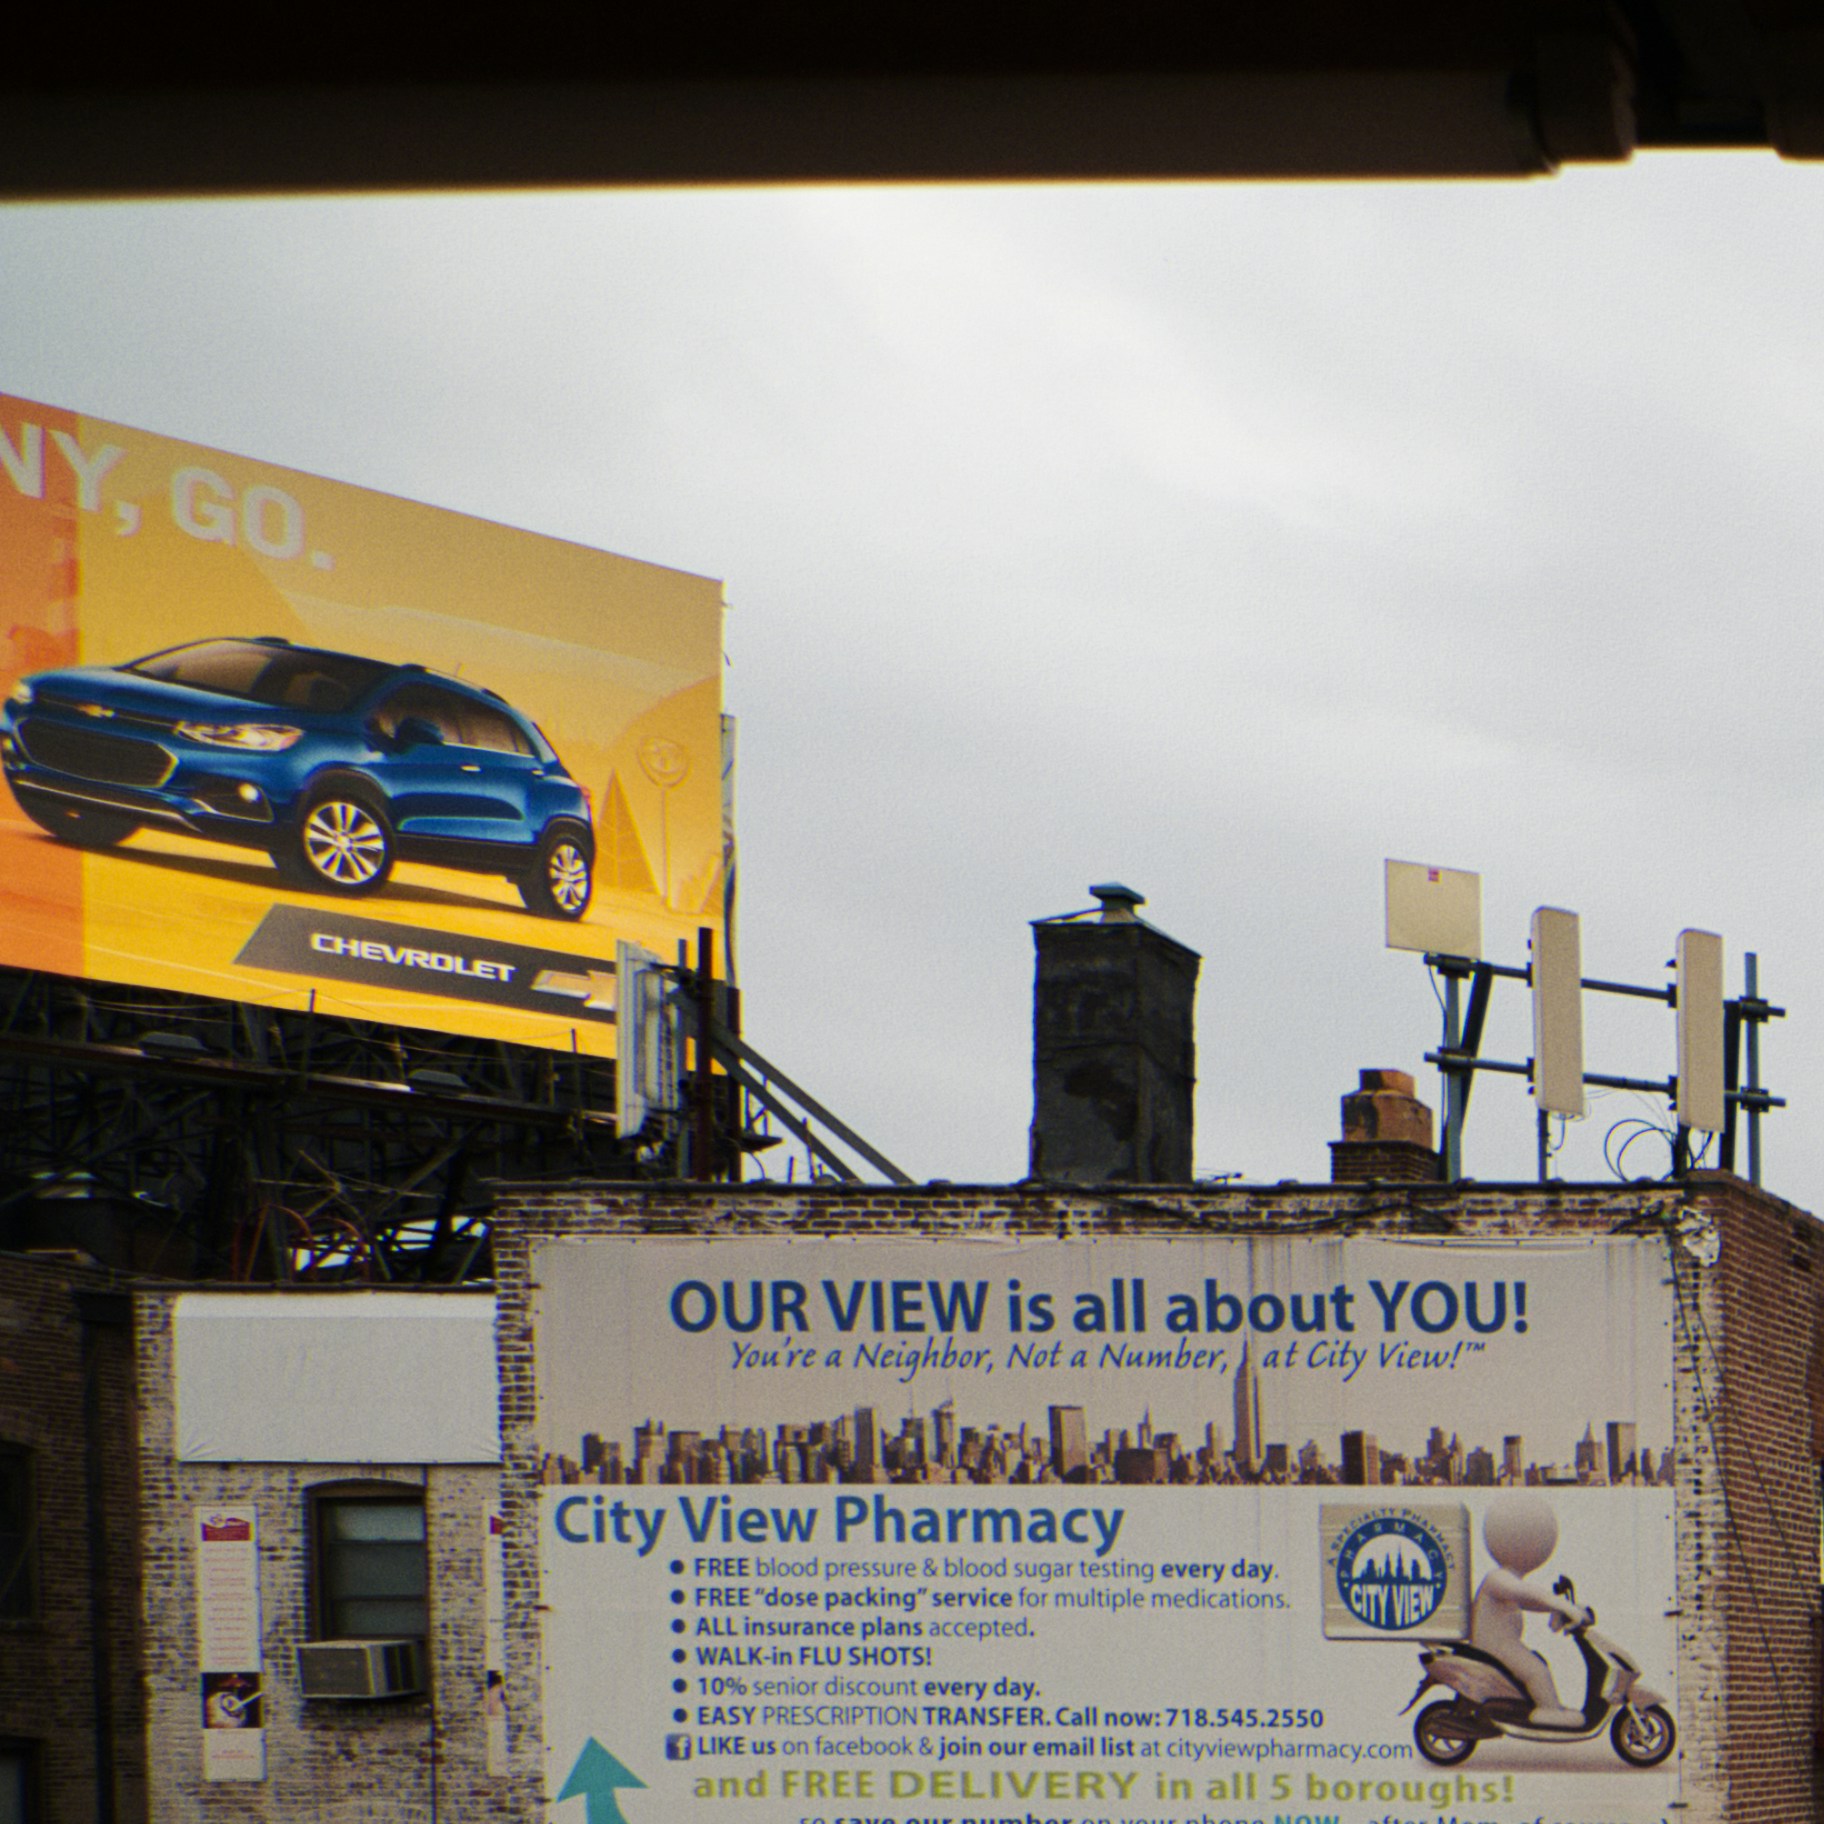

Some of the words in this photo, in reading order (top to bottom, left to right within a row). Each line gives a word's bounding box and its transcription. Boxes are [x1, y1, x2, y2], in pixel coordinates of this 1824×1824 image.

[171, 466, 336, 571] GO.
[311, 933, 516, 983] CHEVROLET
[669, 1279, 810, 1334] OUR
[821, 1279, 990, 1333] VIEW
[1007, 1278, 1056, 1334] is
[1072, 1277, 1147, 1333] all
[1165, 1277, 1356, 1334] about
[1368, 1279, 1529, 1334] YOU!
[823, 1349, 842, 1369] a
[853, 1336, 996, 1384] Neighbor,
[1006, 1341, 1063, 1369] Not
[1069, 1349, 1088, 1369] a
[1098, 1336, 1229, 1373] Number,
[1262, 1343, 1299, 1369] at
[1306, 1340, 1368, 1383] City
[554, 1494, 667, 1558] City
[678, 1494, 819, 1543] View
[834, 1493, 1126, 1558] Pharmacy
[1339, 1521, 1444, 1579] PHARMACY
[693, 1557, 750, 1577] FREE
[755, 1557, 819, 1578] blood
[824, 1562, 918, 1581] pressure
[922, 1559, 938, 1577] &
[944, 1557, 1008, 1578] blood
[1013, 1563, 1074, 1582] sugar
[1079, 1559, 1155, 1583] testing
[1160, 1563, 1226, 1582] every
[1231, 1558, 1279, 1582] day.
[694, 1588, 751, 1607] FREE
[932, 1587, 1013, 1608] service
[1019, 1586, 1050, 1608] for
[1055, 1587, 1146, 1612] multiple
[1151, 1588, 1292, 1609] medications.
[1351, 1583, 1389, 1626] CITY
[1391, 1583, 1434, 1627] VIEW
[695, 1617, 738, 1636] ALL
[744, 1617, 855, 1637] insurance
[861, 1617, 923, 1641] plans
[929, 1617, 1036, 1641] accepted.
[696, 1646, 793, 1667] WALK-in
[800, 1646, 842, 1667] FLU
[849, 1646, 932, 1667] SHOTS!
[698, 1676, 748, 1697] 10%
[753, 1677, 818, 1697] senior
[824, 1676, 916, 1697] discount
[923, 1680, 988, 1701] every
[993, 1676, 1041, 1701] day.
[699, 1706, 756, 1726] EASY
[762, 1706, 918, 1727] PRESCRIPTION
[923, 1706, 1051, 1727] TRANSFER.
[1055, 1706, 1098, 1727] Call
[1103, 1711, 1161, 1727] now:
[1165, 1707, 1325, 1729] 718.545.2550
[699, 1736, 746, 1756] LIKE
[752, 1741, 777, 1756] us
[783, 1741, 809, 1757] on
[814, 1735, 913, 1757] facebook
[918, 1736, 934, 1757] &
[938, 1736, 983, 1761] join
[989, 1741, 1027, 1757] our
[1032, 1736, 1095, 1758] email
[1101, 1736, 1135, 1758] list
[1140, 1739, 1161, 1758] at
[1166, 1738, 1414, 1763] cityviewpharmacy.com
[693, 1770, 768, 1799] and
[781, 1770, 876, 1800] FREE
[890, 1770, 1140, 1801] DELIVERY
[1156, 1772, 1193, 1801] in
[1206, 1772, 1258, 1802] all
[1268, 1772, 1292, 1802] 5
[1306, 1772, 1515, 1809] boroughs!
